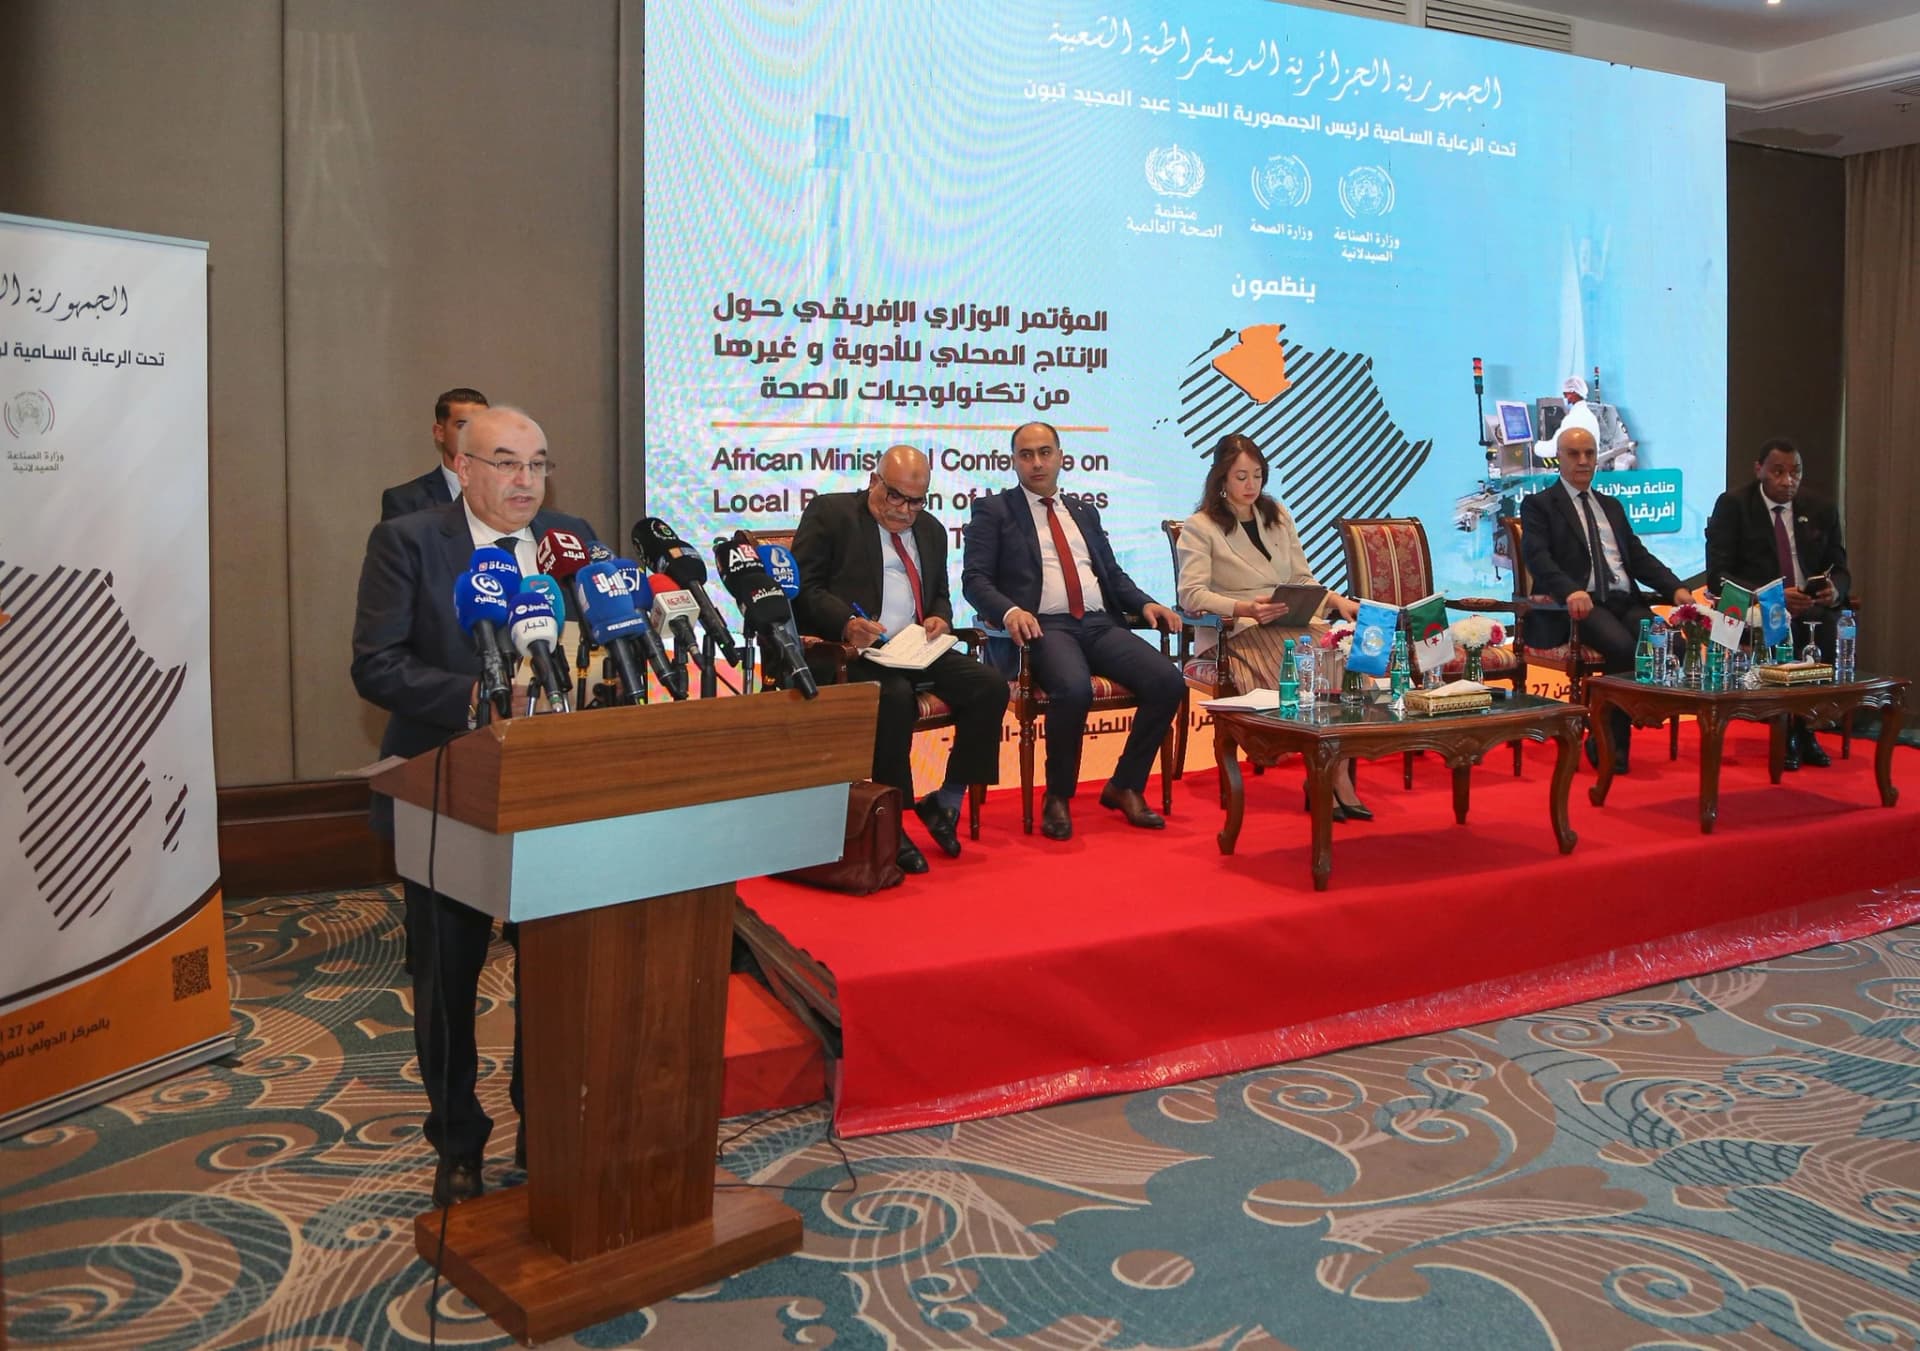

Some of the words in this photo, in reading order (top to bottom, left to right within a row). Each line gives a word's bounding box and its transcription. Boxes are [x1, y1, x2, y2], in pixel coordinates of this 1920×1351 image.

[1139, 21, 1280, 80] الديمقراطية
[1285, 49, 1391, 102] الجزائرية
[1024, 79, 1066, 101] تبون
[1073, 87, 1132, 107] المجيد
[1396, 75, 1502, 112] الجمهورية
[1140, 95, 1171, 114] عبد
[1177, 100, 1228, 120] السيد
[1233, 103, 1321, 134] الجمهورية
[1325, 119, 1370, 141] لرئيس
[1373, 123, 1433, 146] السامية
[1437, 131, 1484, 156] الرعاية
[1488, 140, 1517, 157] تحت
[1154, 204, 1197, 221] منظمة
[1126, 217, 1176, 234] العالمية
[1179, 221, 1223, 239] الصحة
[1250, 219, 1285, 236] الصحة
[1286, 223, 1313, 241] وزارة
[1333, 227, 1373, 244] الصناعة
[1375, 231, 1400, 249] وزارة
[1340, 246, 1393, 264] الصيدلانية
[1231, 273, 1316, 303] ينظمون
[26, 284, 129, 321] الجمهورية
[713, 293, 784, 321] حول
[793, 298, 917, 328] الإفريقي
[924, 304, 1009, 330] الوزاري
[1016, 306, 1108, 335] المؤتمر
[14, 342, 76, 362] السامية
[82, 346, 131, 368] الرعاية
[136, 352, 165, 367] تحت
[713, 333, 797, 364] غيرها
[807, 340, 823, 366] و
[832, 335, 922, 367] للأدوية
[930, 342, 1025, 369] المحلي
[1033, 344, 1107, 374] الإنتاج
[760, 376, 848, 401] الصحة
[858, 380, 1025, 410] تكنولوجيات
[1033, 384, 1070, 411] من
[711, 447, 803, 472] African
[811, 448, 933, 471] Ministl
[941, 449, 1074, 471] Confee
[1081, 454, 1108, 471] on
[1643, 482, 1675, 495] صناعة
[713, 488, 788, 513] Local
[1629, 501, 1675, 522] إفريقيا
[488, 560, 518, 574] الحياة
[523, 618, 549, 633] أخبار
[8, 1023, 23, 1039] 27
[27, 1018, 45, 1035] من
[70, 1016, 111, 1043] بالمركز
[28, 1030, 67, 1054] الدولي
